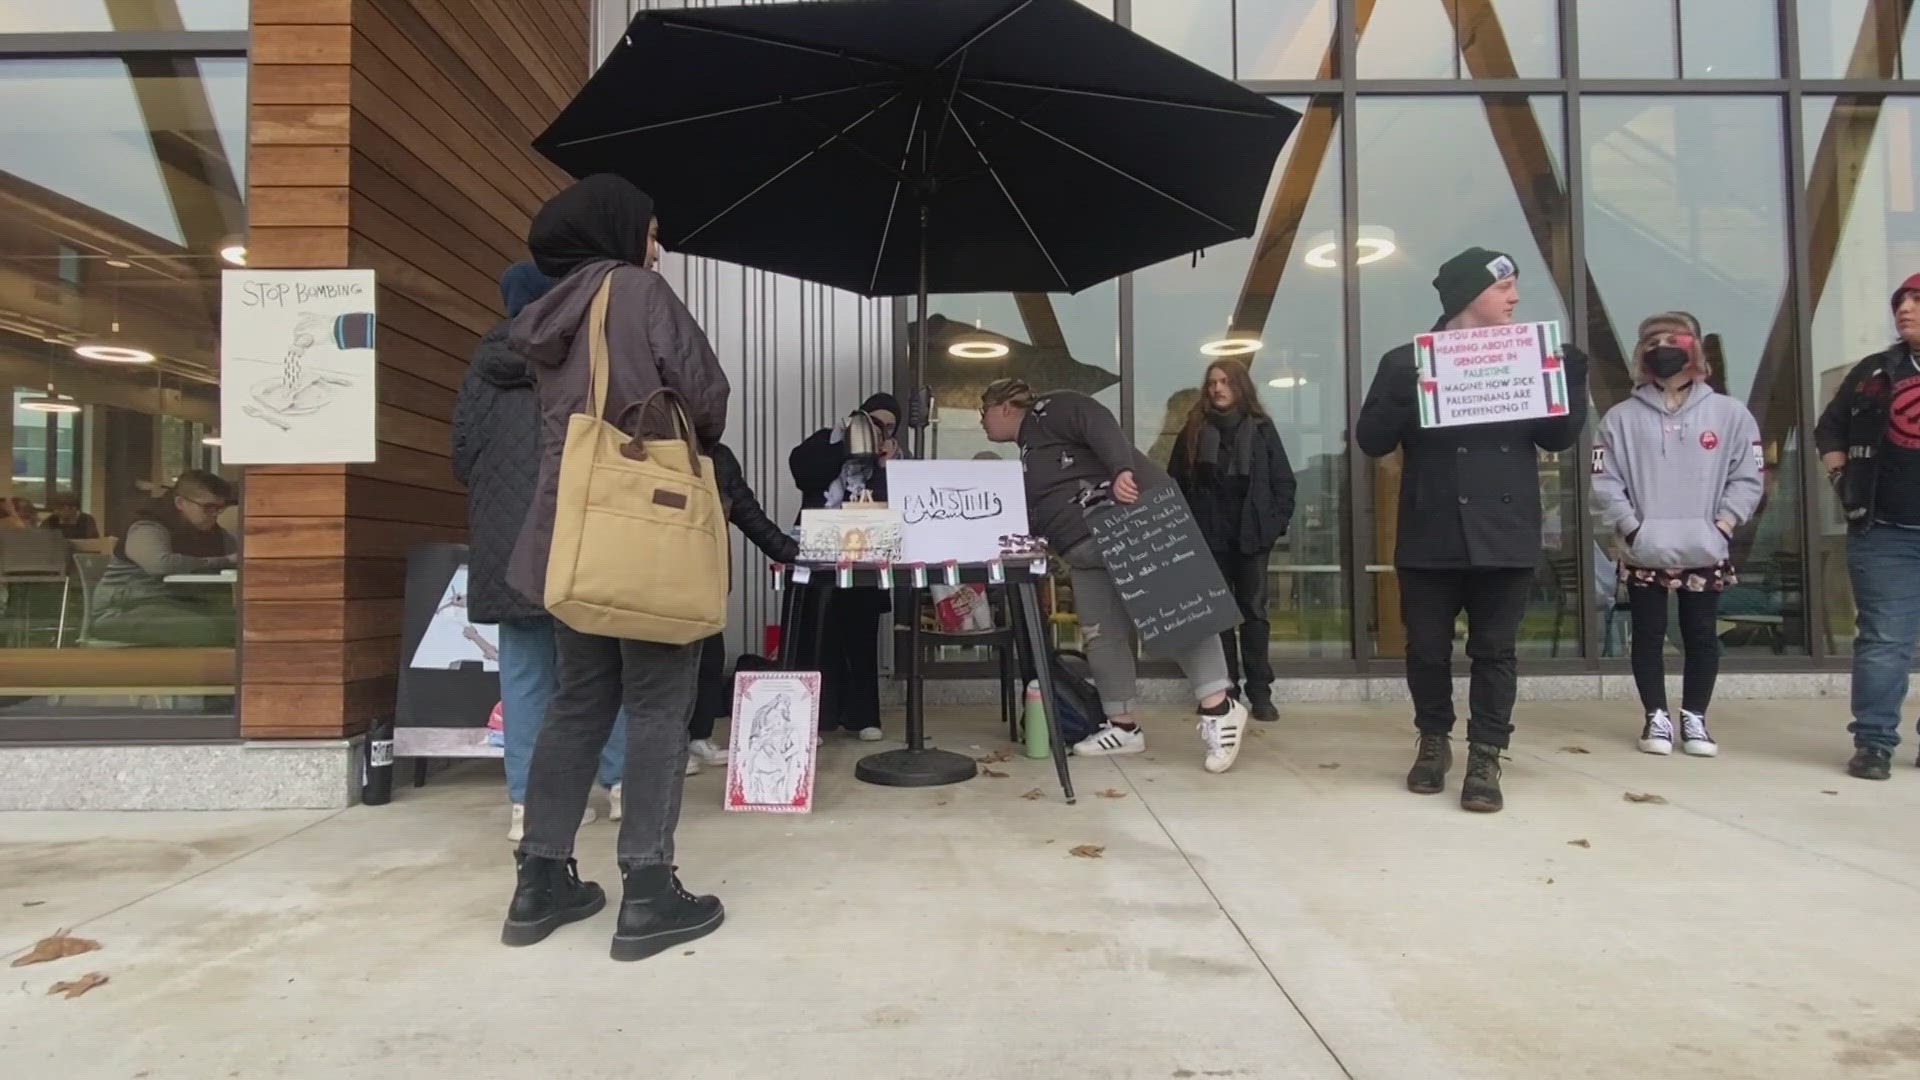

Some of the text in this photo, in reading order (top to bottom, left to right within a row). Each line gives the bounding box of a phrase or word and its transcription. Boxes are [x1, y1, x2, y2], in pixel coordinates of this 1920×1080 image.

[242, 280, 363, 308] STOP BOMBING
[1448, 331, 1468, 340] YOU
[1471, 330, 1489, 338] ARE
[1491, 328, 1513, 337] SICK
[1515, 326, 1528, 334] OF
[1436, 337, 1534, 354] HEARING ABOUT THE
[1454, 352, 1517, 366] GENOCIDE IN
[1463, 366, 1510, 378] PALESTINE
[1442, 376, 1535, 392] IMAGINE HOW SICK
[1446, 389, 1531, 405] PALESTINIANS ARE
[1451, 401, 1529, 418] EXPERIENCING IT
